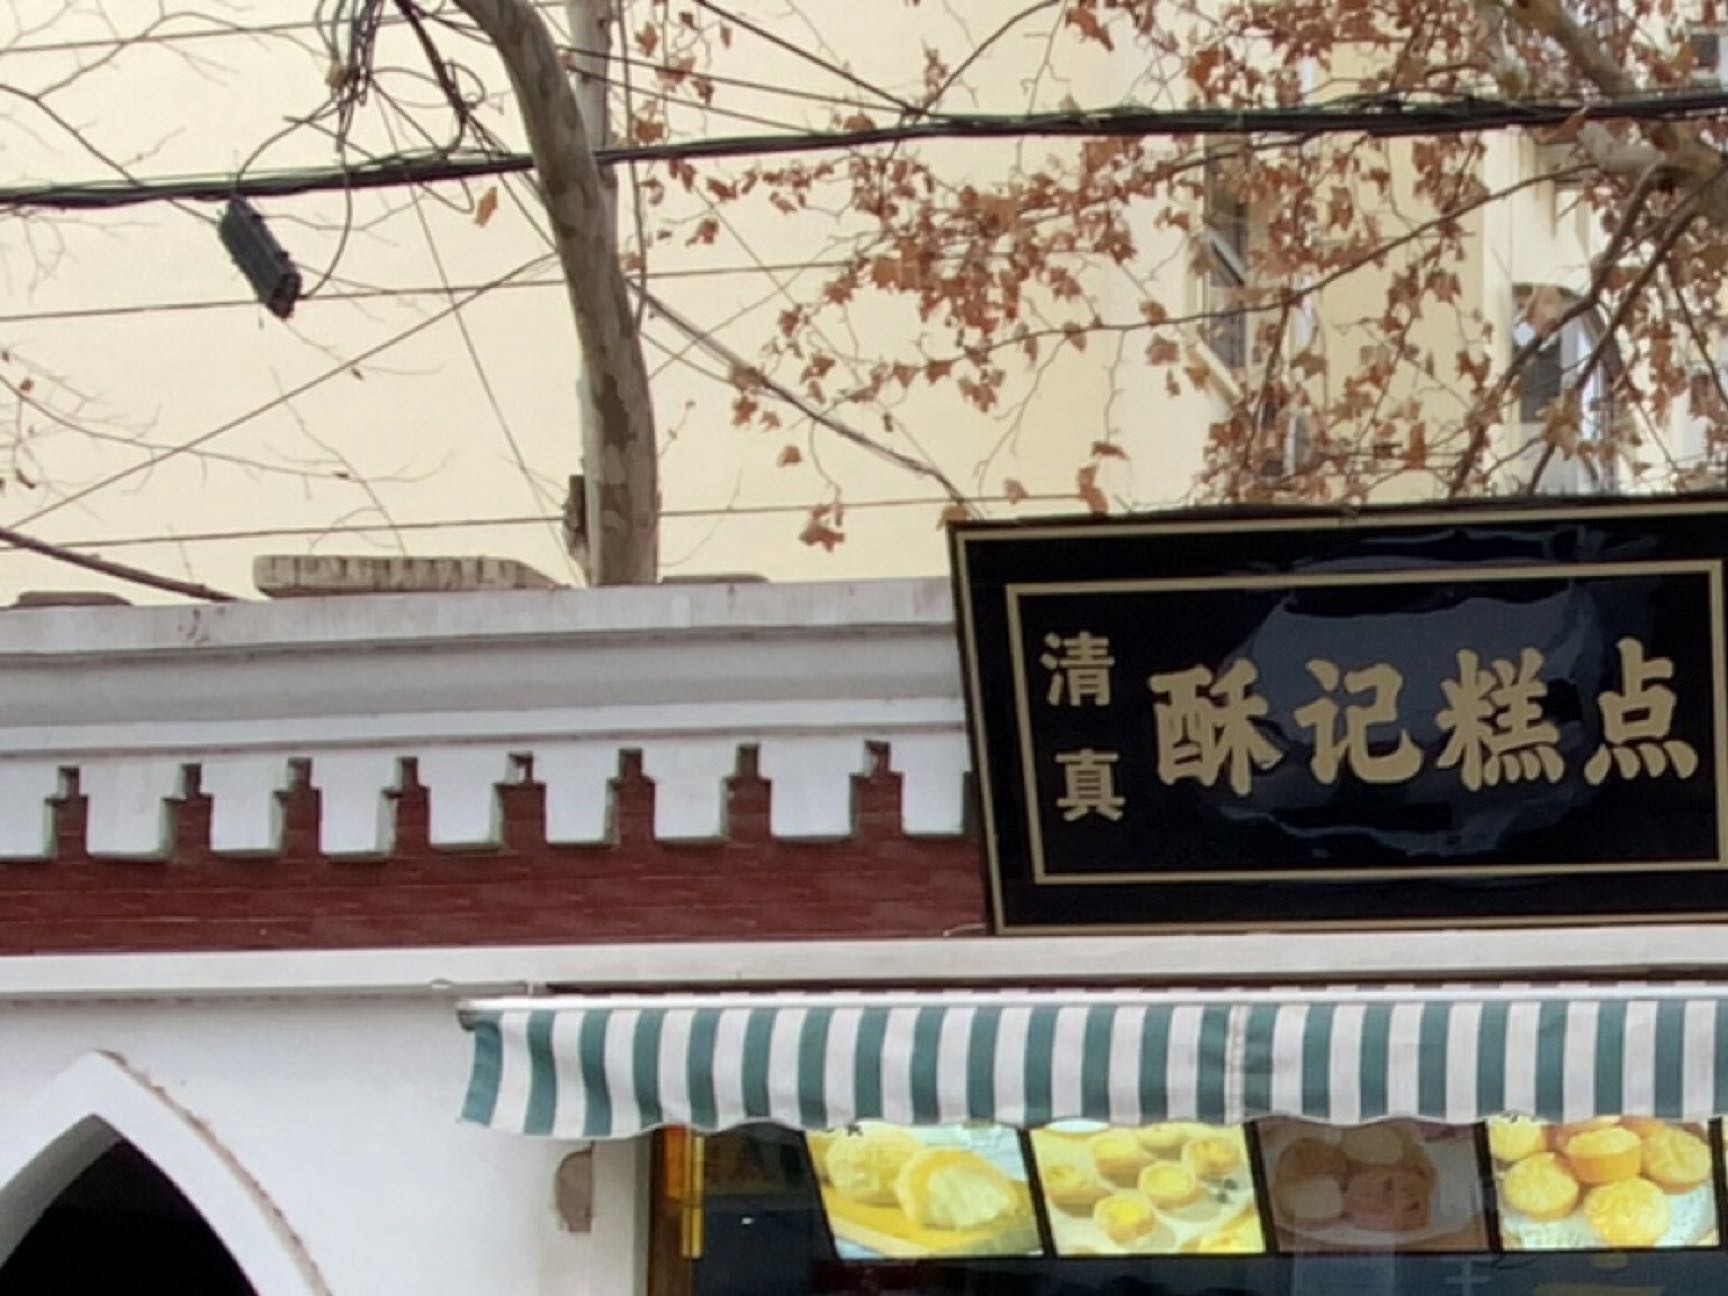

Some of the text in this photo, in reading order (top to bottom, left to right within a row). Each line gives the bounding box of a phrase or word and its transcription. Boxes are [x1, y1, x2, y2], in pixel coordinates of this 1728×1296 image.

[1038, 630, 1125, 824] 清真
[1148, 637, 1700, 796] 酥记糕点
